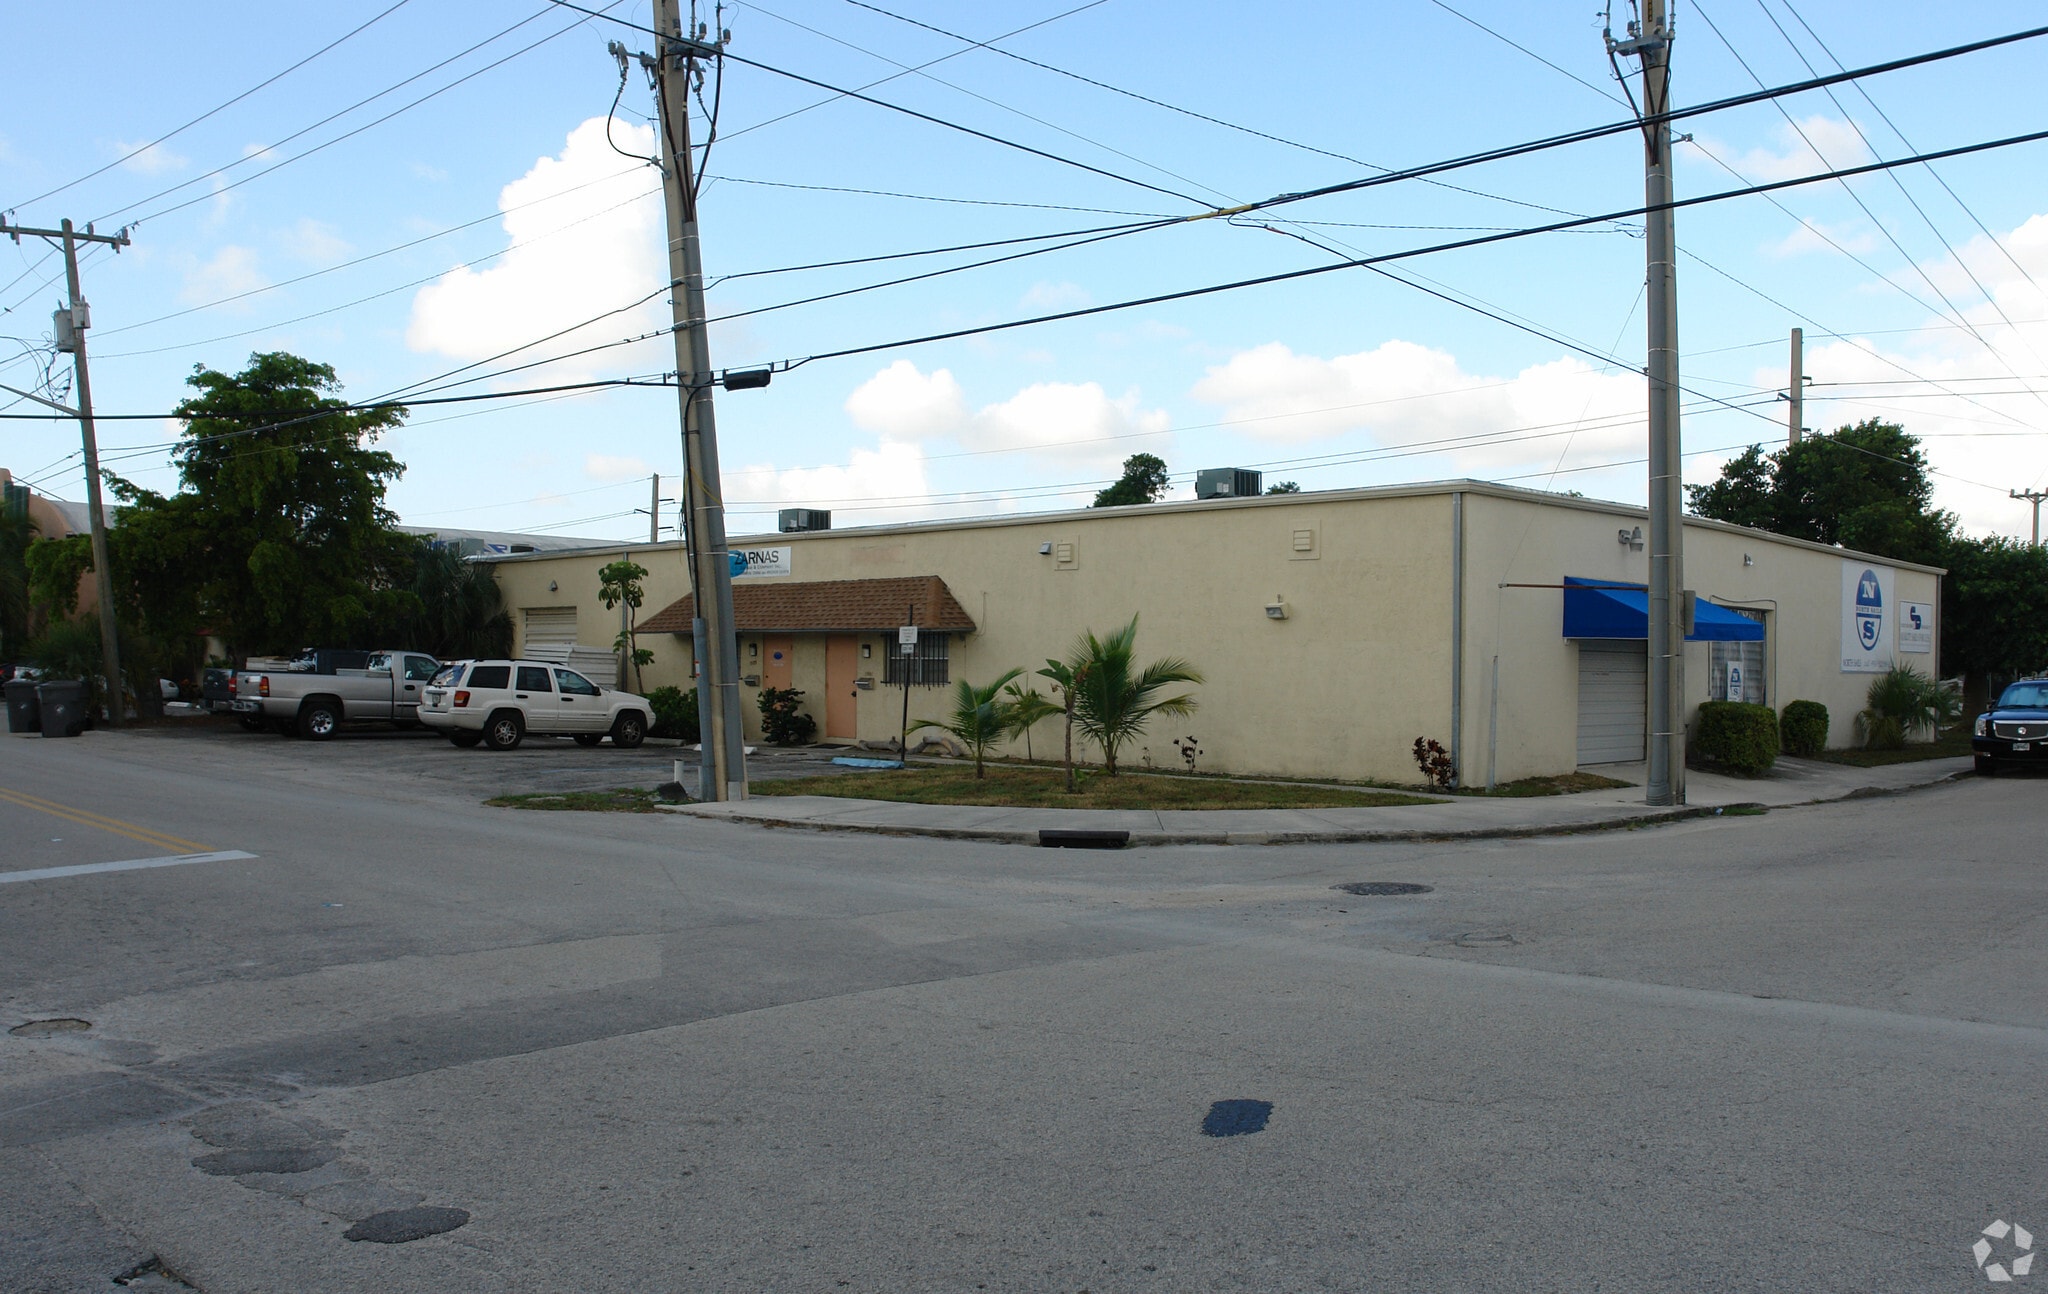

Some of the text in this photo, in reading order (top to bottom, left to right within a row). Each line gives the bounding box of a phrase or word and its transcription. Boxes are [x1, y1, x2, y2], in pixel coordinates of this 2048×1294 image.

[735, 551, 779, 564] ZARNAS
[1862, 581, 1876, 598] N
[1863, 620, 1874, 640] S
